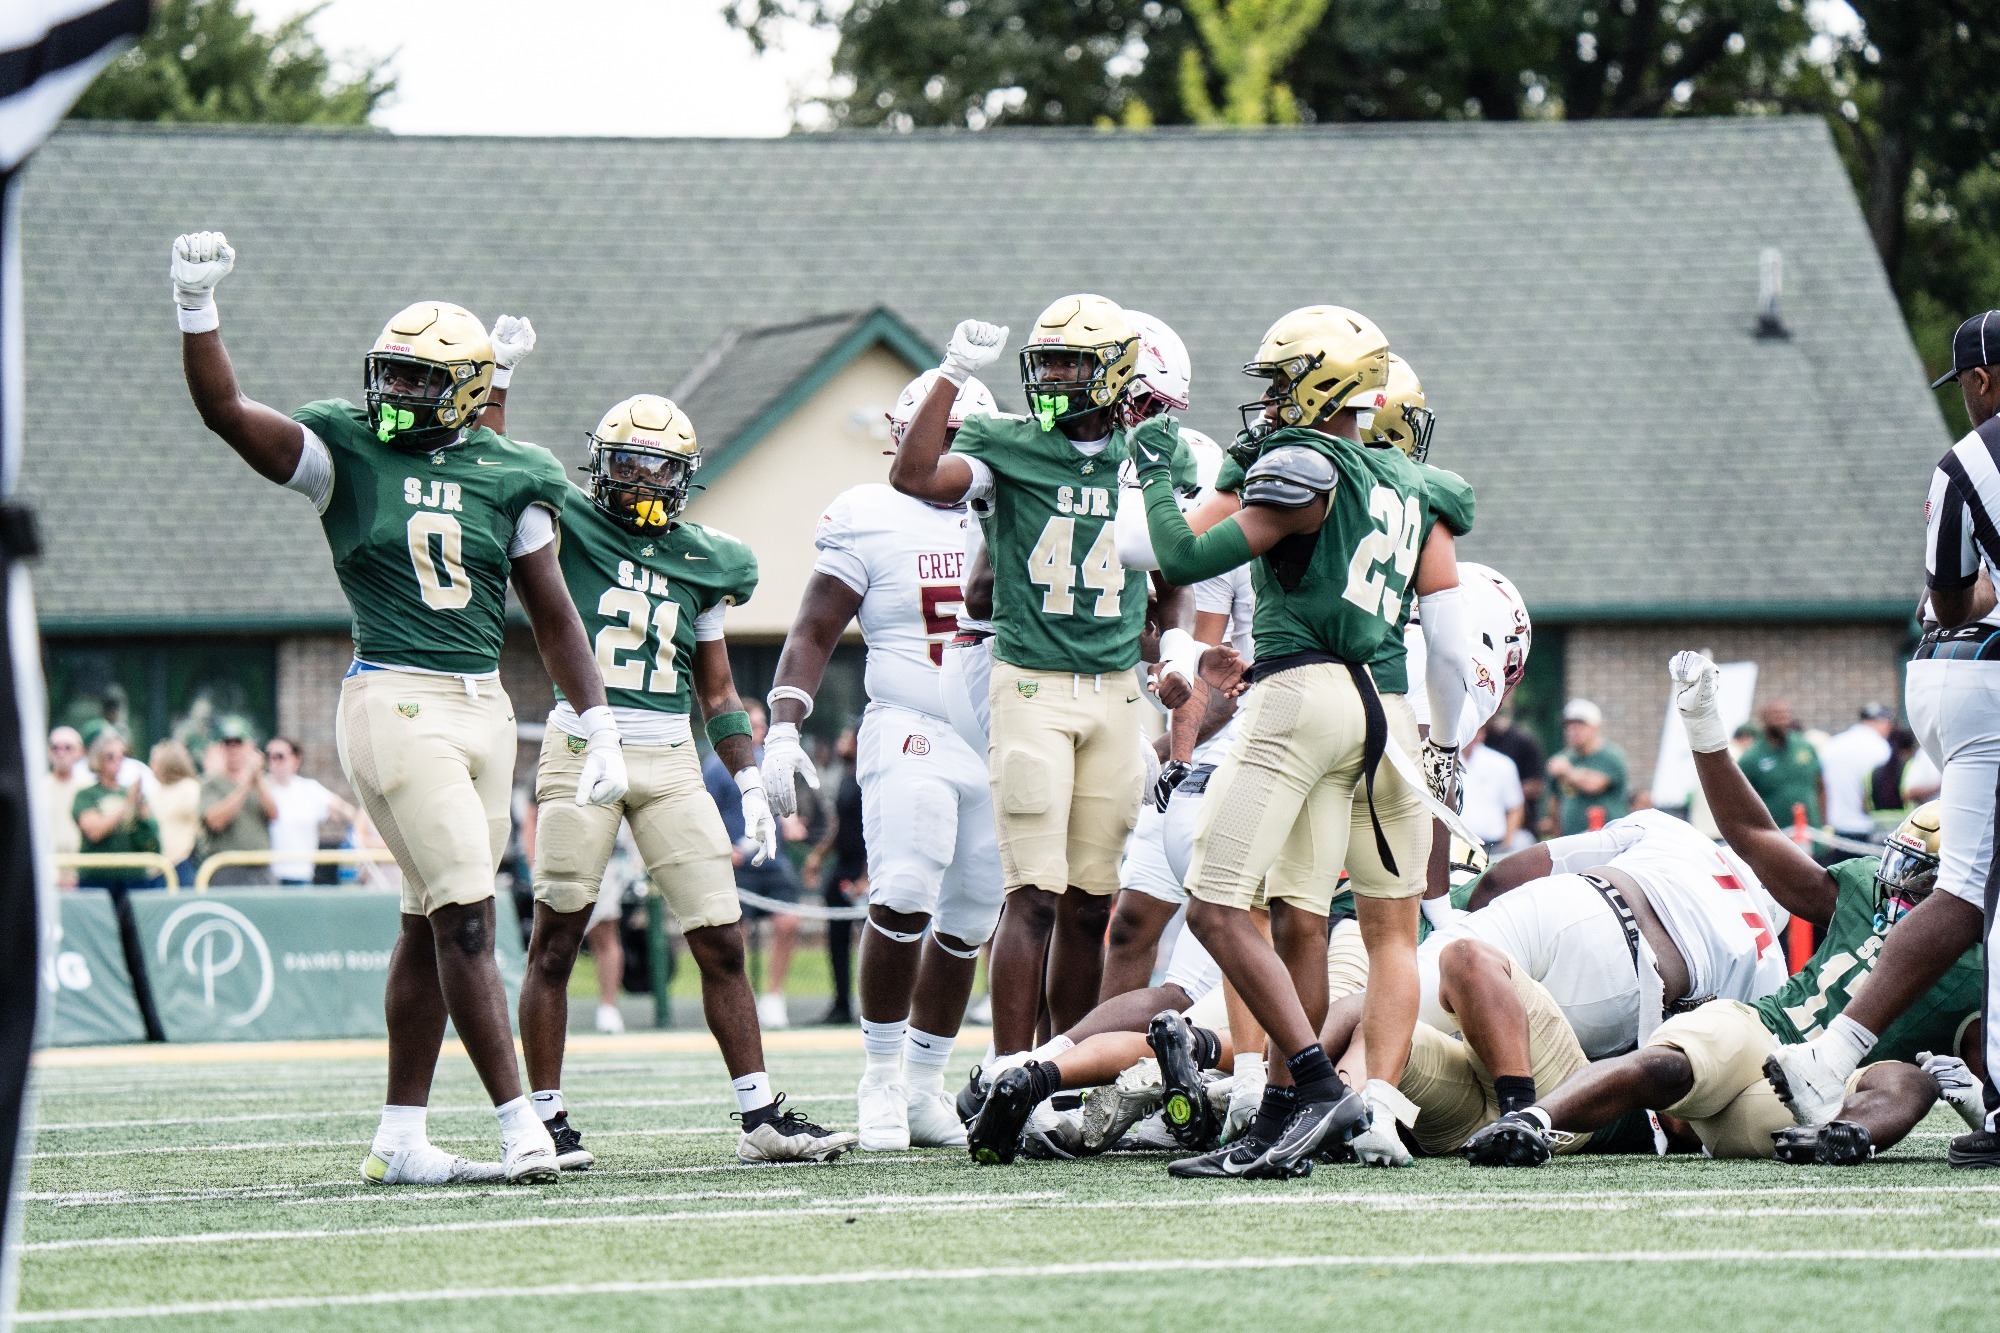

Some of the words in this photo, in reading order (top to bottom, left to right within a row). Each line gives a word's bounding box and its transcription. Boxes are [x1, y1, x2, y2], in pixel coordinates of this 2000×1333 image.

[384, 343, 411, 353] Riddell
[631, 436, 661, 448] Riddell
[403, 476, 463, 512] SJR
[1056, 485, 1110, 517] SJR
[406, 510, 473, 611] 0
[1027, 515, 1126, 617] 44
[1341, 480, 1422, 627] 29
[617, 559, 669, 597] SJR
[594, 586, 681, 694] 21
[911, 736, 926, 754] C
[1899, 833, 1923, 849] Riddell
